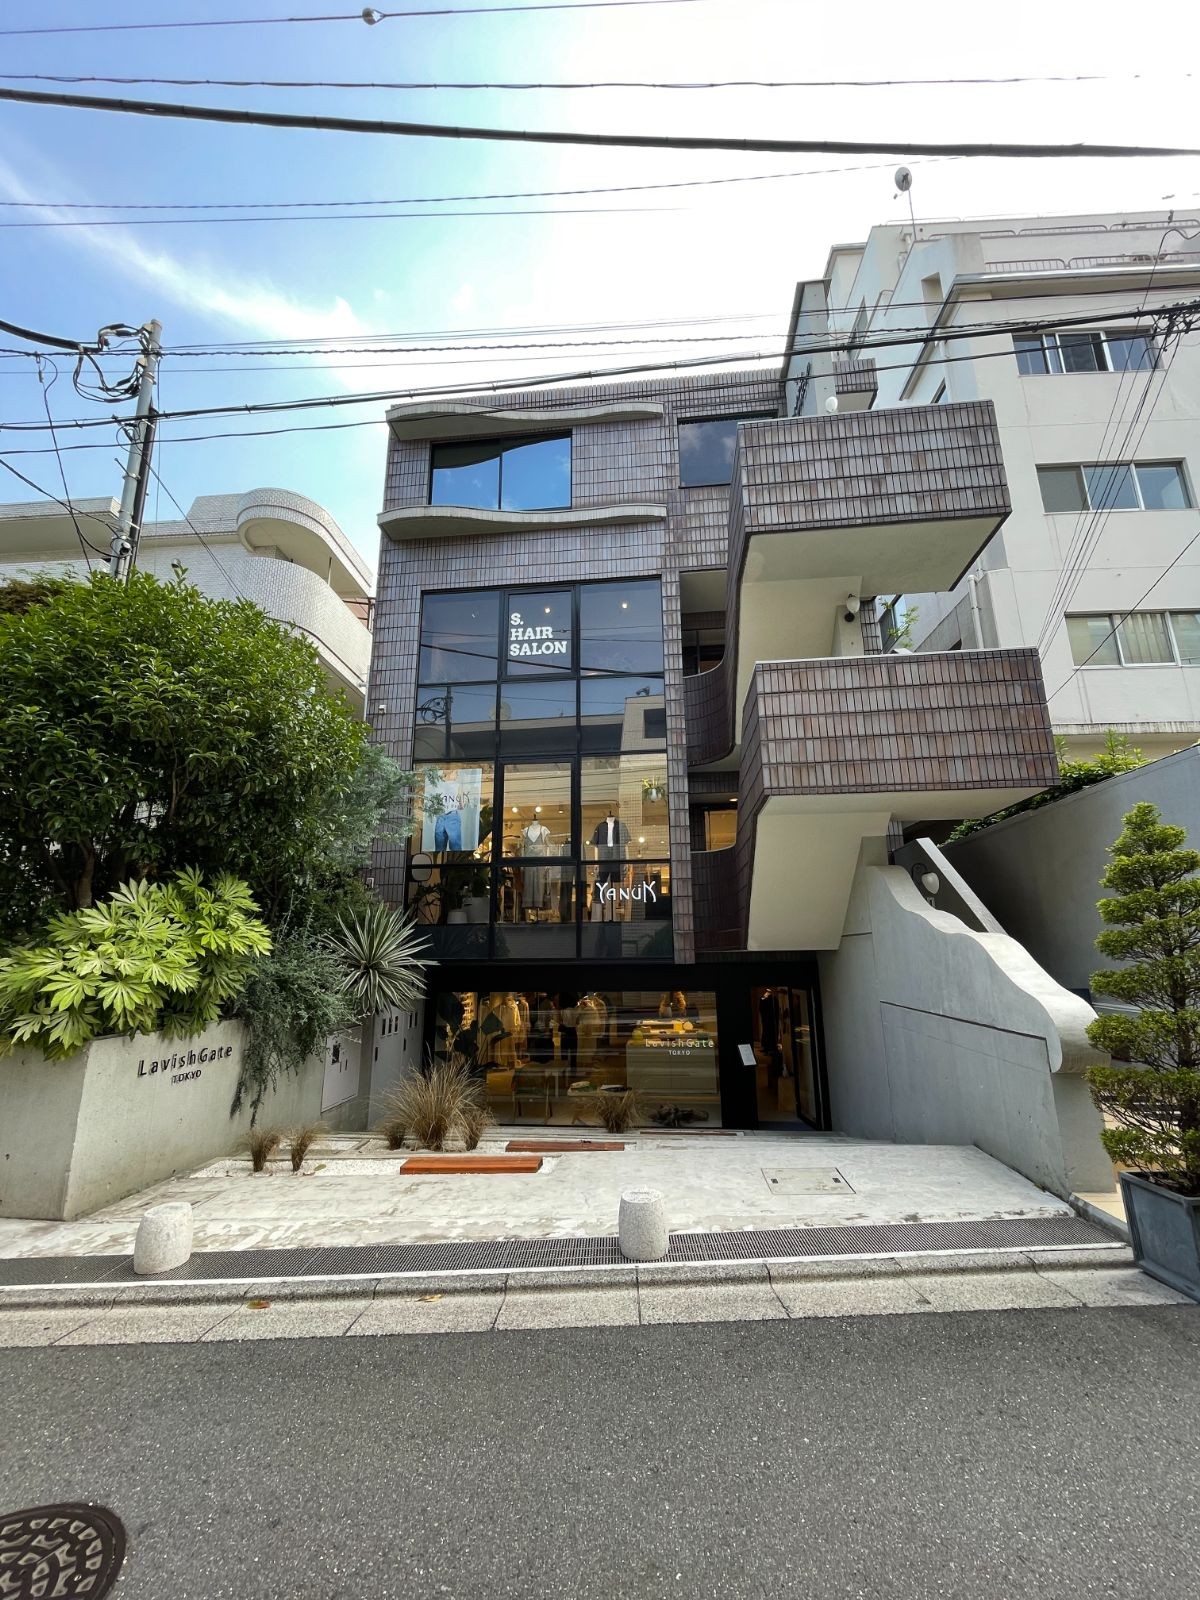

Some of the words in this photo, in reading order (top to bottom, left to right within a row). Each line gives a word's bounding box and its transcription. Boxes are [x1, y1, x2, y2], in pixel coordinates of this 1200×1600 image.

[510, 612, 524, 625] S.
[510, 626, 554, 641] HAIR
[509, 641, 567, 657] SALON
[645, 1039, 715, 1048] LavishGate
[138, 1045, 233, 1078] LavishGate
[172, 1069, 202, 1084] TOKYO
